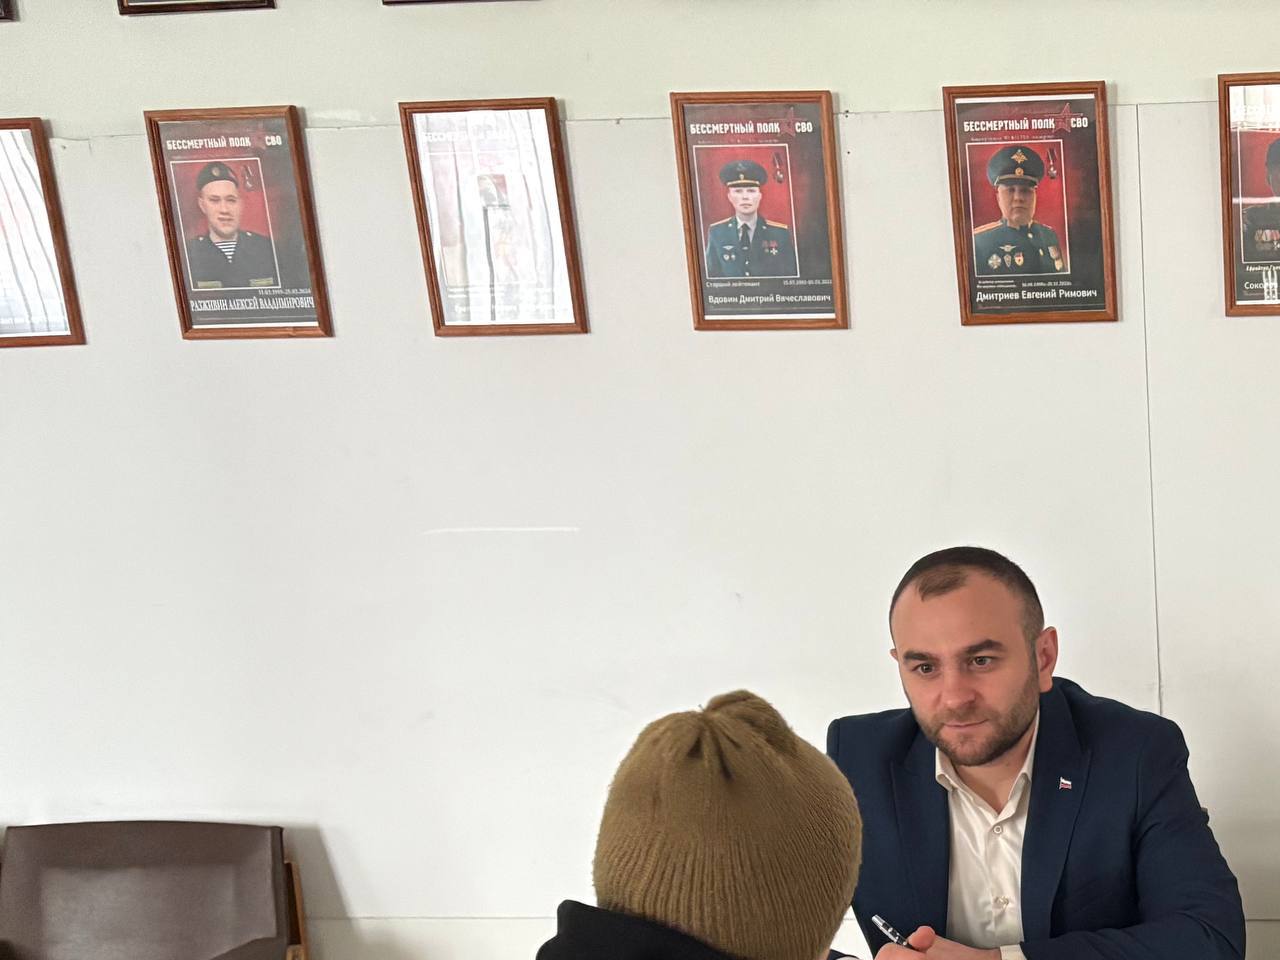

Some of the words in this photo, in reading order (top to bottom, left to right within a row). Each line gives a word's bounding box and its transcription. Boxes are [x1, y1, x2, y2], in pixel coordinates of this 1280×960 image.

[690, 120, 754, 134] БЕССМЕРТНЫЙ
[757, 121, 780, 133] ПОЛК
[795, 121, 813, 133] СВО
[964, 117, 1029, 132] БЕССМЕРТНЫЙ
[1031, 118, 1055, 129] ПОЛК
[1070, 117, 1089, 128] СВО
[166, 136, 226, 150] БЕССМЕРТНЫЙ
[229, 137, 251, 148] ПОЛК
[265, 135, 282, 146] СВО
[708, 295, 738, 304] Вдовин
[740, 293, 774, 304] Дмитрий
[976, 291, 1020, 302] Дмитриев
[1021, 289, 1057, 299] Евгений
[1059, 289, 1098, 298] Римович
[190, 299, 228, 312] РАЗЖИВИН
[229, 296, 260, 311] АЛЕКСЕЙ
[260, 296, 316, 310] ВЛАДИМИРОВИЧ
